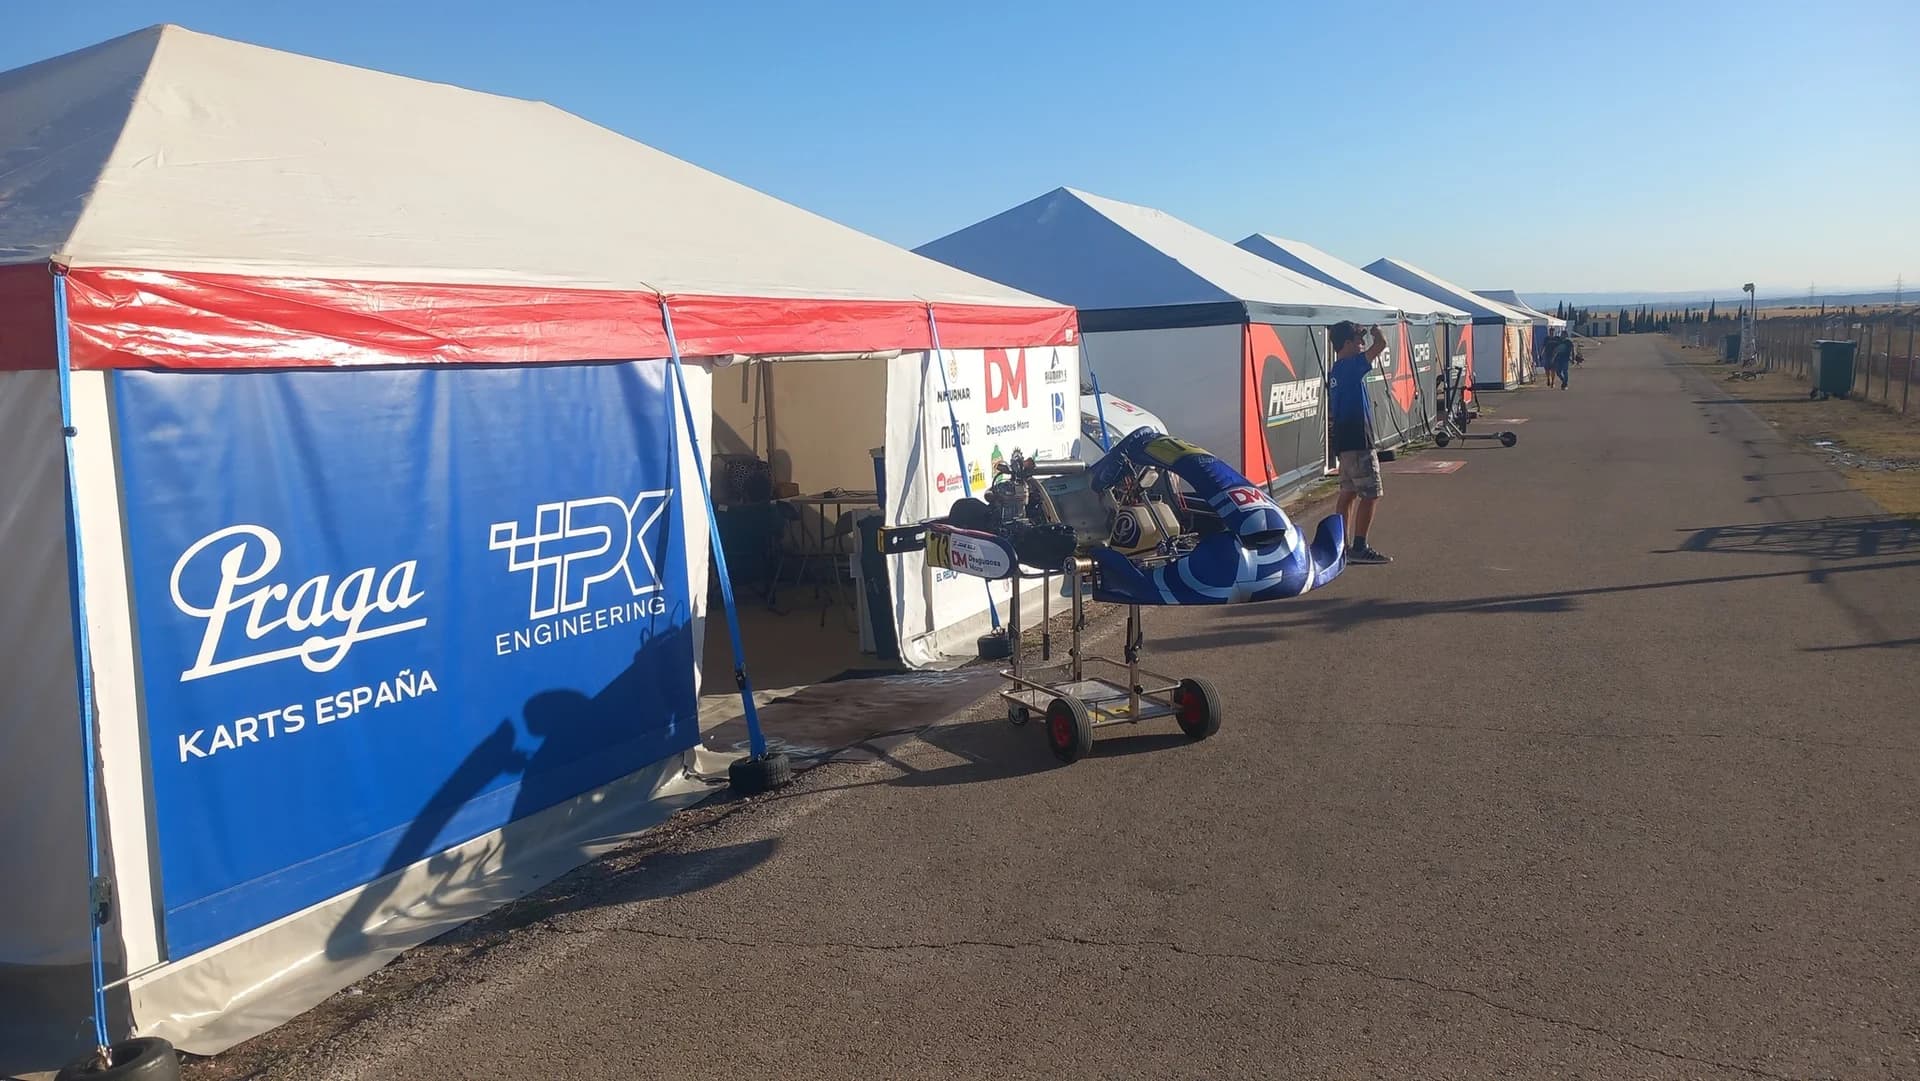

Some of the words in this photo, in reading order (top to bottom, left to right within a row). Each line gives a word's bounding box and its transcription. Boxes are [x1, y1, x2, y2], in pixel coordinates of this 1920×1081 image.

[984, 348, 1028, 413] DM
[169, 524, 428, 682] Praga
[496, 596, 666, 656] ENGINEERING
[178, 704, 305, 763] KARTS
[315, 668, 438, 725] ESPAÑA
